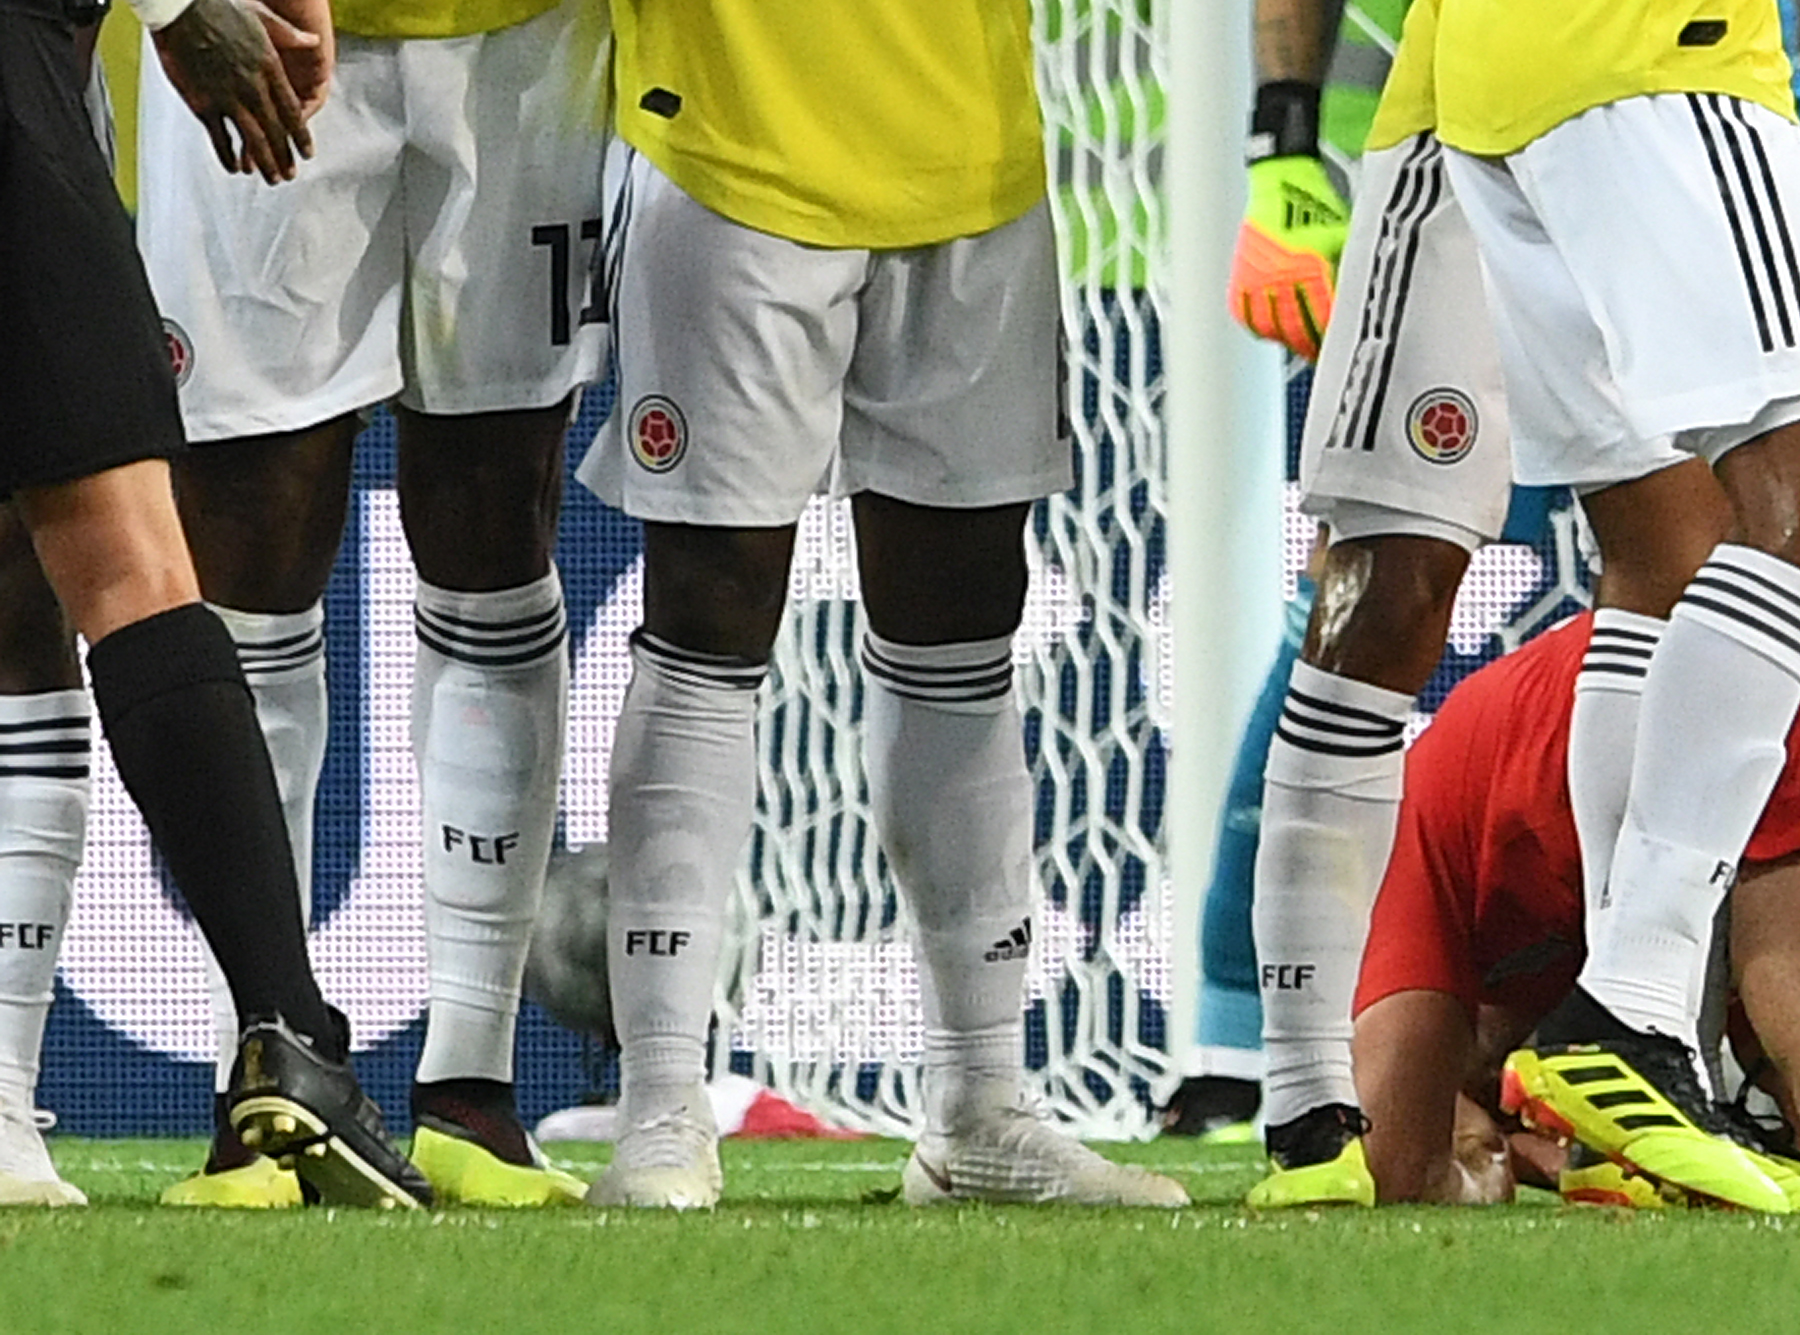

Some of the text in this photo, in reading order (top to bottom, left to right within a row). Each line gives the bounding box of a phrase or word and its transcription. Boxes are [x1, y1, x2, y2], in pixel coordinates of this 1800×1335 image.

[441, 823, 520, 865] FCF
[0, 922, 55, 951] FCF
[626, 929, 692, 957] FCF
[1261, 963, 1316, 990] FCF
